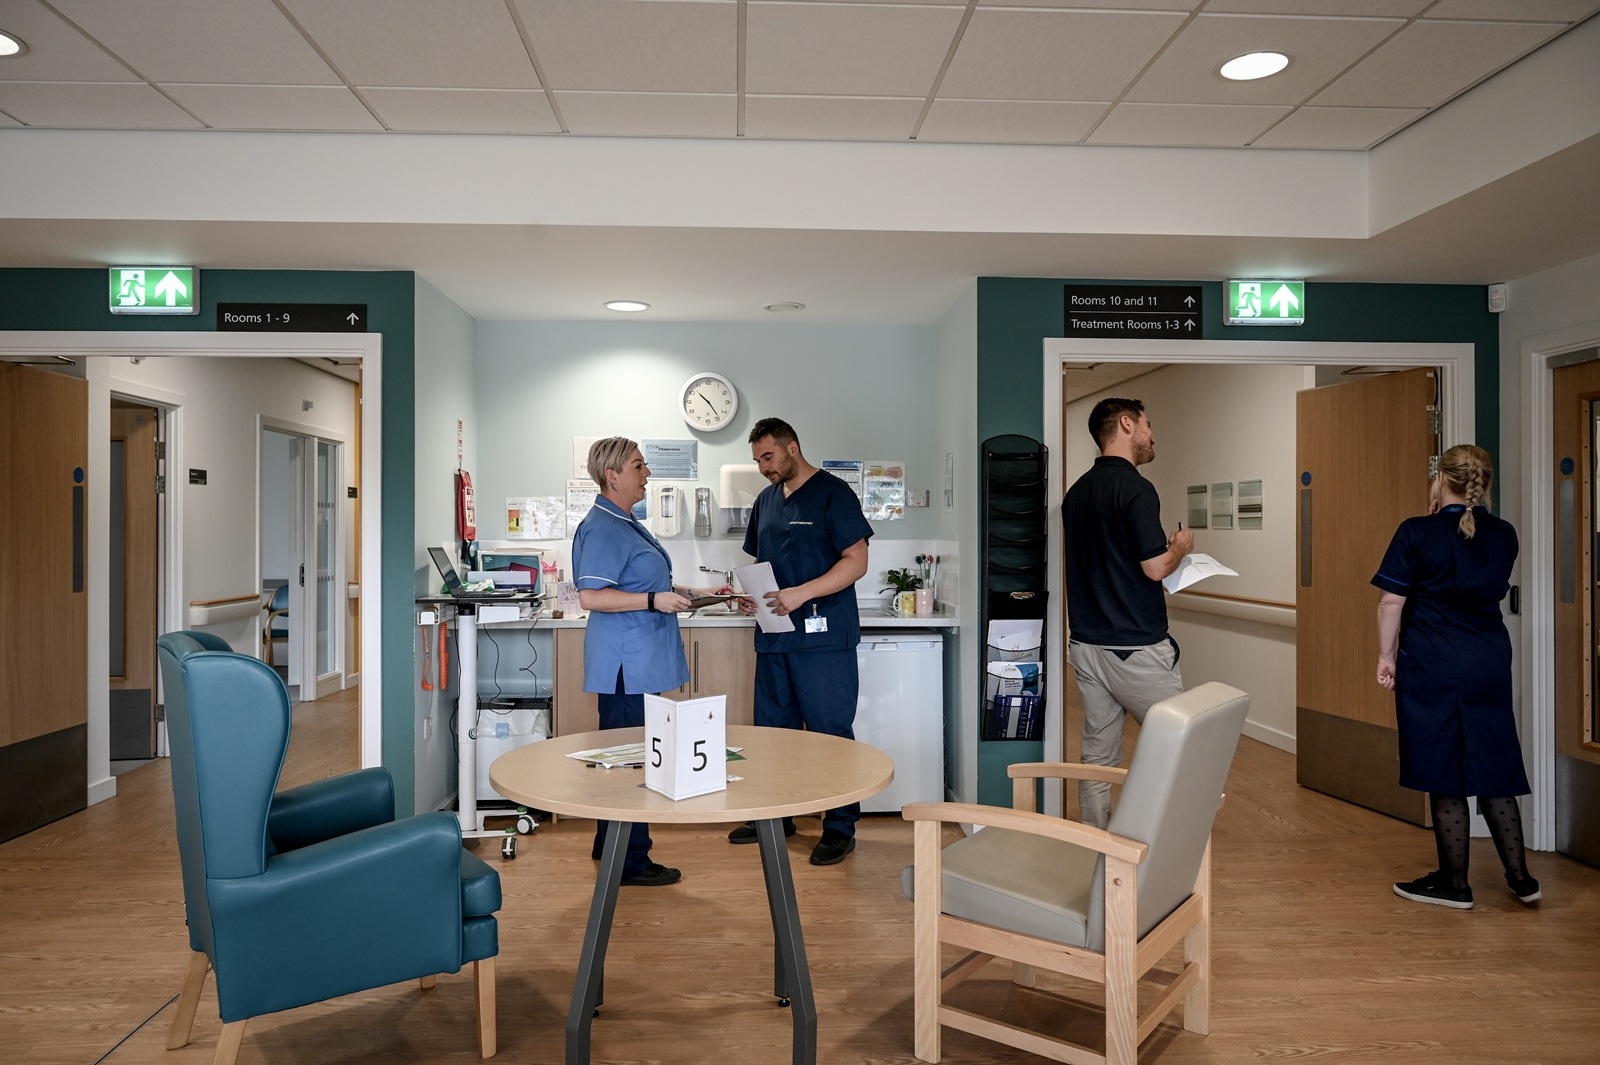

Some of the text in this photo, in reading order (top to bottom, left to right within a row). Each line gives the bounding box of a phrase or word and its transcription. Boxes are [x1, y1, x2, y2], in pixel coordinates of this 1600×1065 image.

[1071, 295, 1157, 306] Rooms 10 and 11
[224, 312, 262, 323] Rooms
[266, 313, 271, 323] 1
[283, 313, 290, 323] 9
[1071, 318, 1180, 330] Treatment Rooms 1-3
[651, 736, 663, 769] 5
[692, 739, 708, 772] 5
